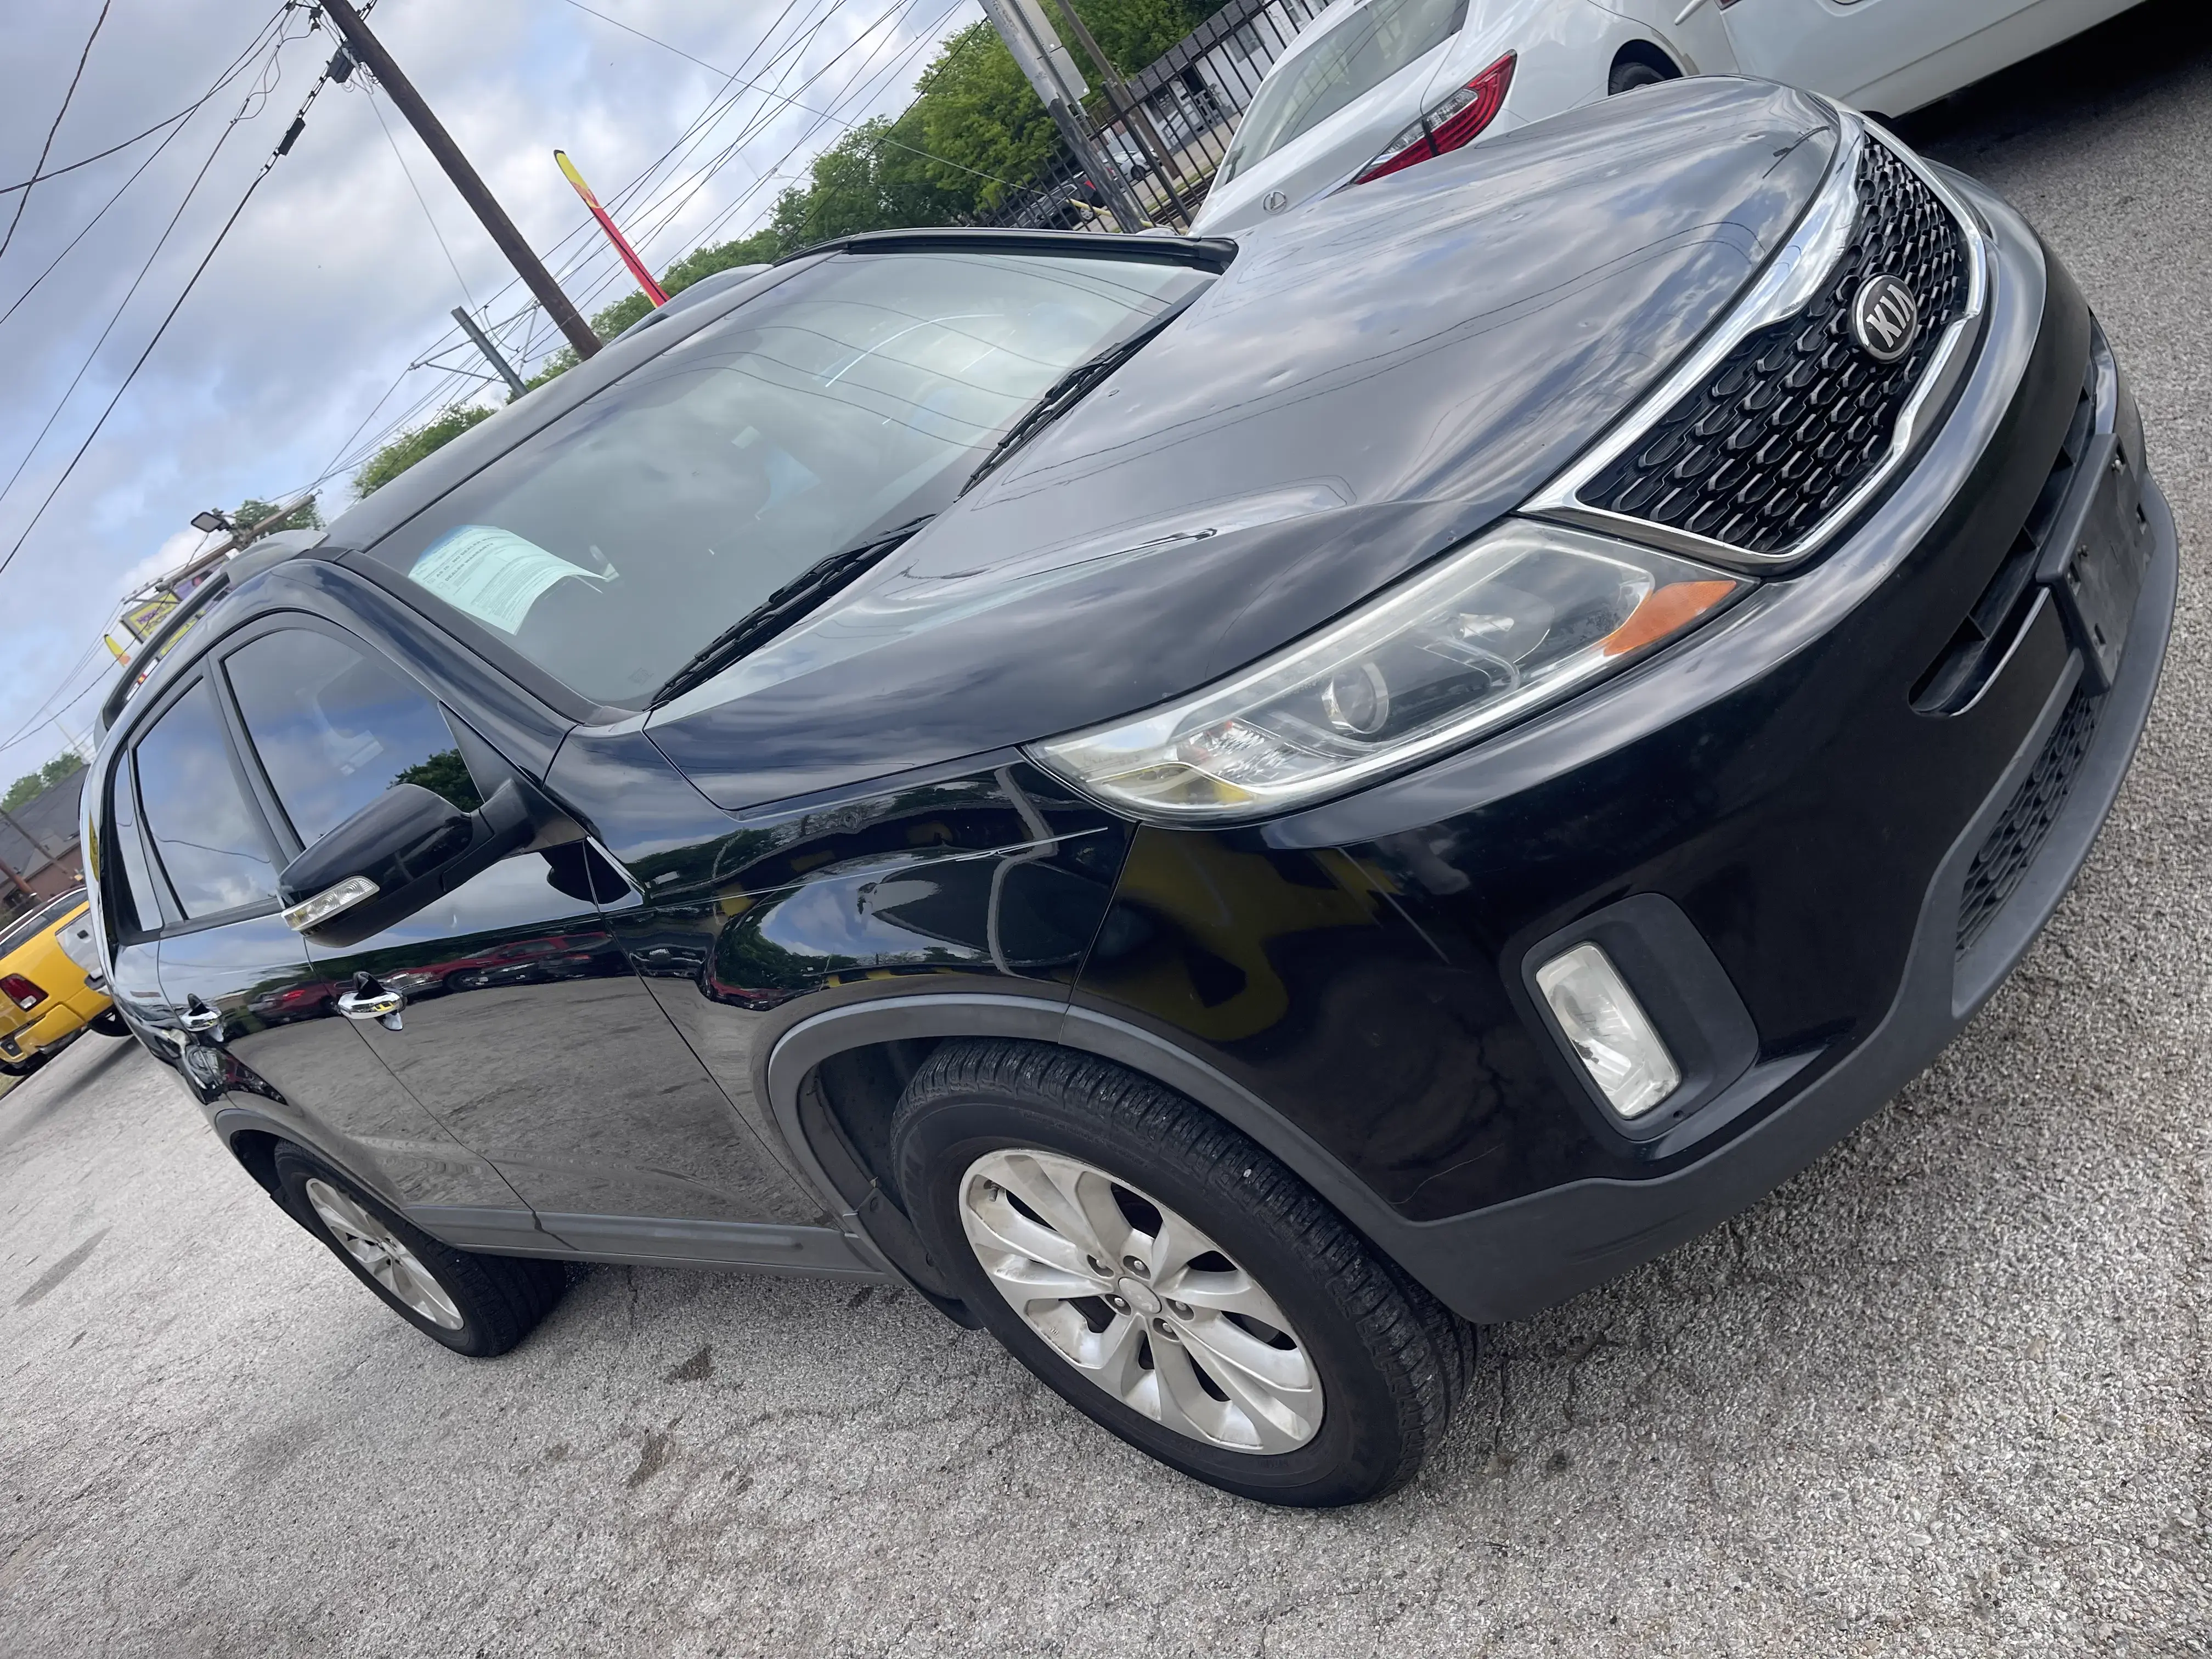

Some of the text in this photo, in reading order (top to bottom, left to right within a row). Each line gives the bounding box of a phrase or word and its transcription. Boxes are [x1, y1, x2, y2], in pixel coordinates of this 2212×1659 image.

[1866, 284, 1914, 348] KIA
[445, 564, 465, 581] DEALER
[465, 543, 494, 563] WARRANTY
[460, 540, 481, 555] DEALER
